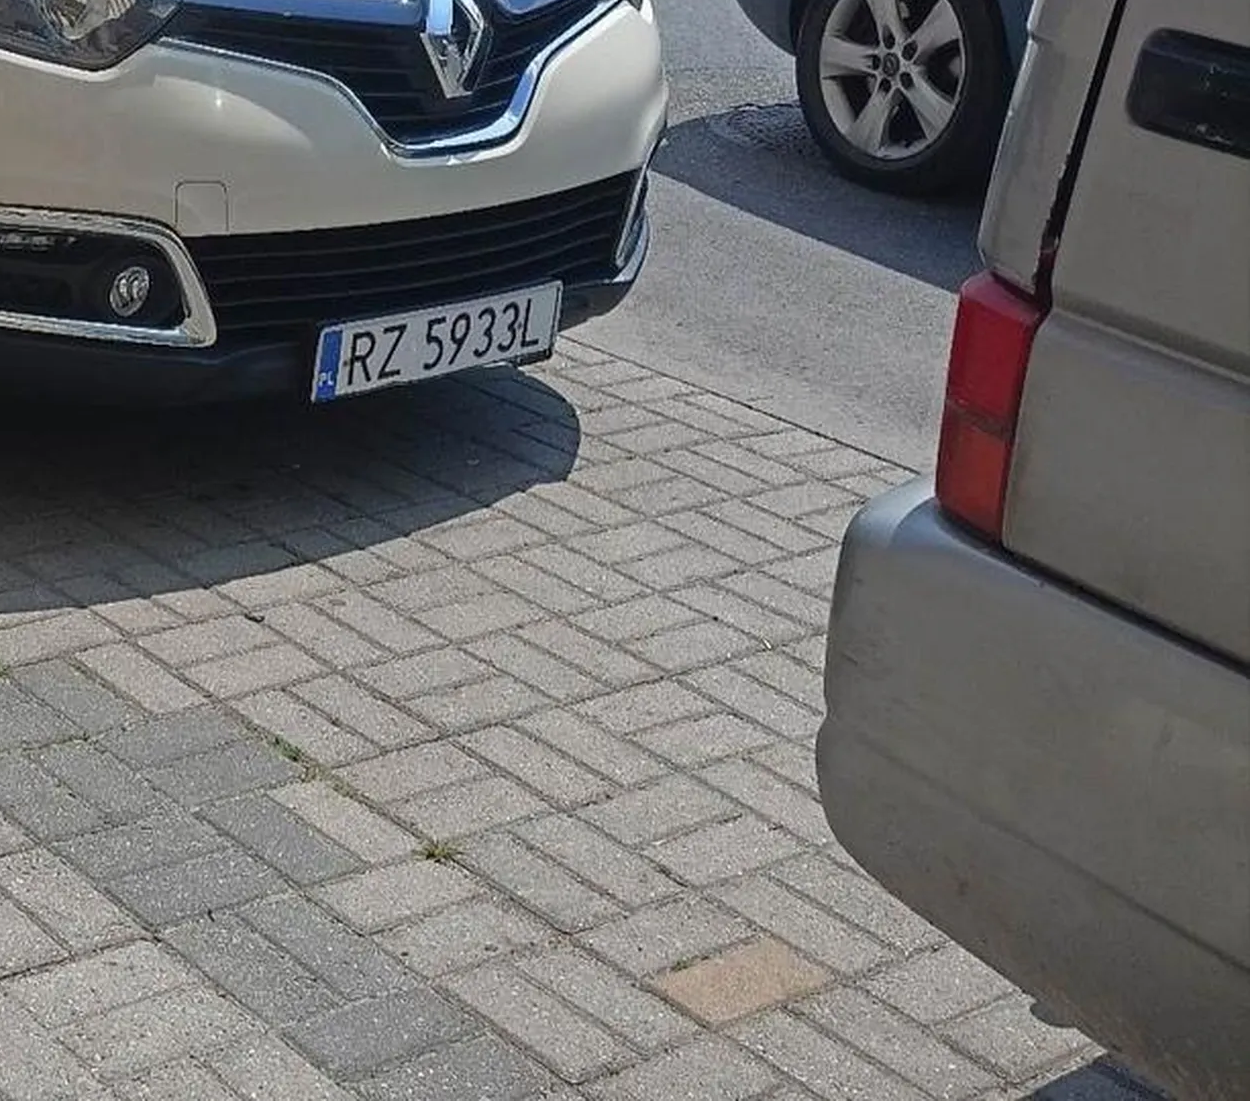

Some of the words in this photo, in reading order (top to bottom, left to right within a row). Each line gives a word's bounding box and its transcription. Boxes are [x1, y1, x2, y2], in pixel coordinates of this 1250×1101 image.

[347, 324, 409, 386] RZ
[422, 298, 540, 372] 5933L
[318, 371, 334, 387] PL
